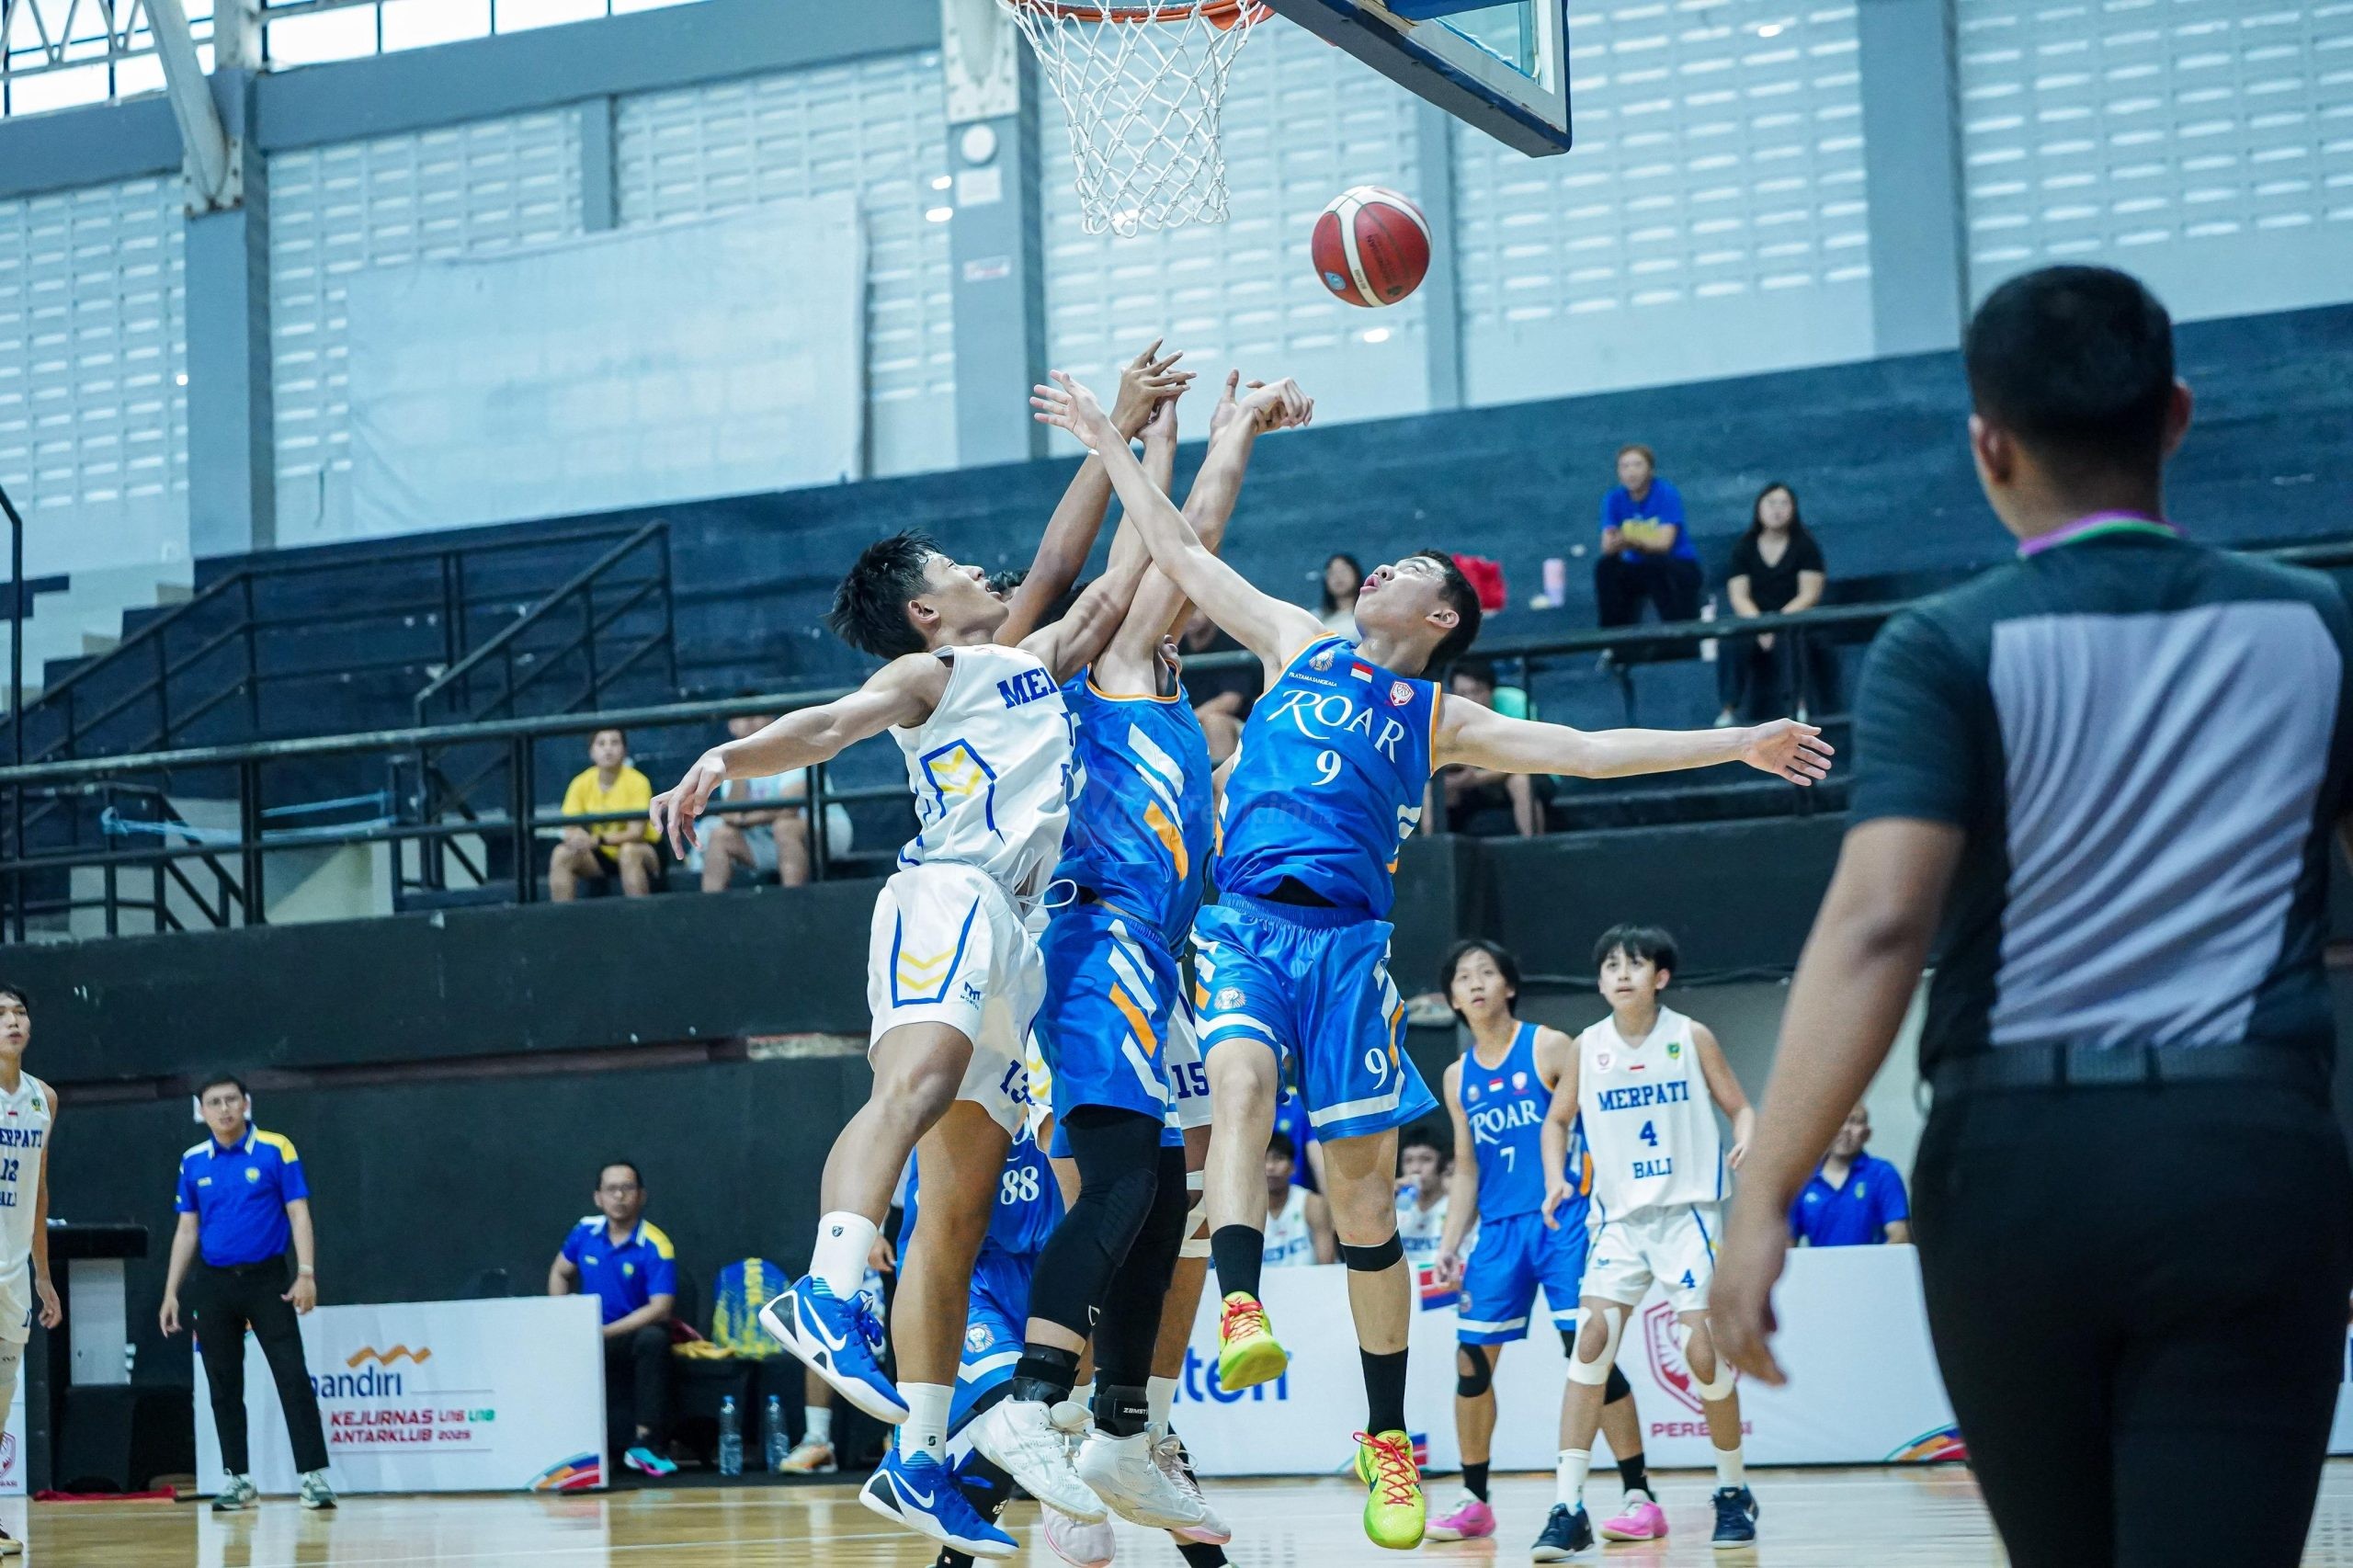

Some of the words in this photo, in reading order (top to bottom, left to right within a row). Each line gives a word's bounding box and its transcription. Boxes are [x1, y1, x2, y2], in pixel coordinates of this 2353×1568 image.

[1266, 689, 1404, 764] ROAR
[1311, 750, 1342, 786] 9
[1171, 1062, 1211, 1099] 15
[1364, 1048, 1389, 1090] 9
[1597, 1080, 1689, 1112] MERPATI
[1469, 1099, 1545, 1145] ROAR
[1639, 1119, 1658, 1147] 4
[1500, 1146, 1516, 1174] 7
[1632, 1157, 1673, 1179] BALI
[1000, 1165, 1040, 1206] 88
[1680, 1268, 1696, 1289] 4
[331, 1409, 433, 1426] KEJURNAS
[331, 1428, 433, 1444] ANTARKLUB
